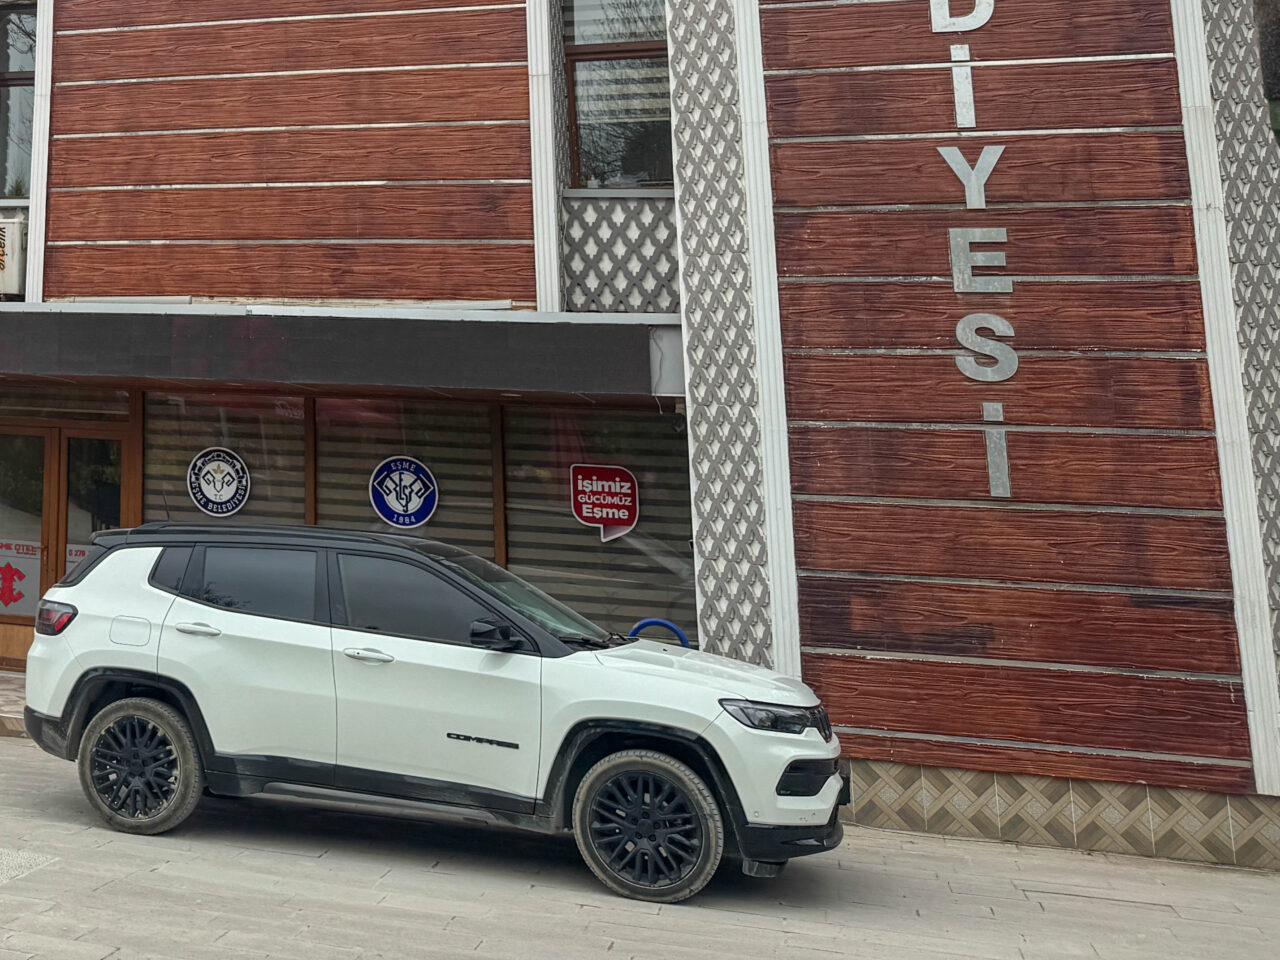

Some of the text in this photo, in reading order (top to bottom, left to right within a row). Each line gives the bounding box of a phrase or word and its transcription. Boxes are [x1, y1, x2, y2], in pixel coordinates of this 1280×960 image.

[390, 460, 417, 471] EŞME
[577, 493, 632, 506] GÜCÜMÜZ
[582, 504, 629, 519] Eşme
[393, 514, 416, 524] 1984
